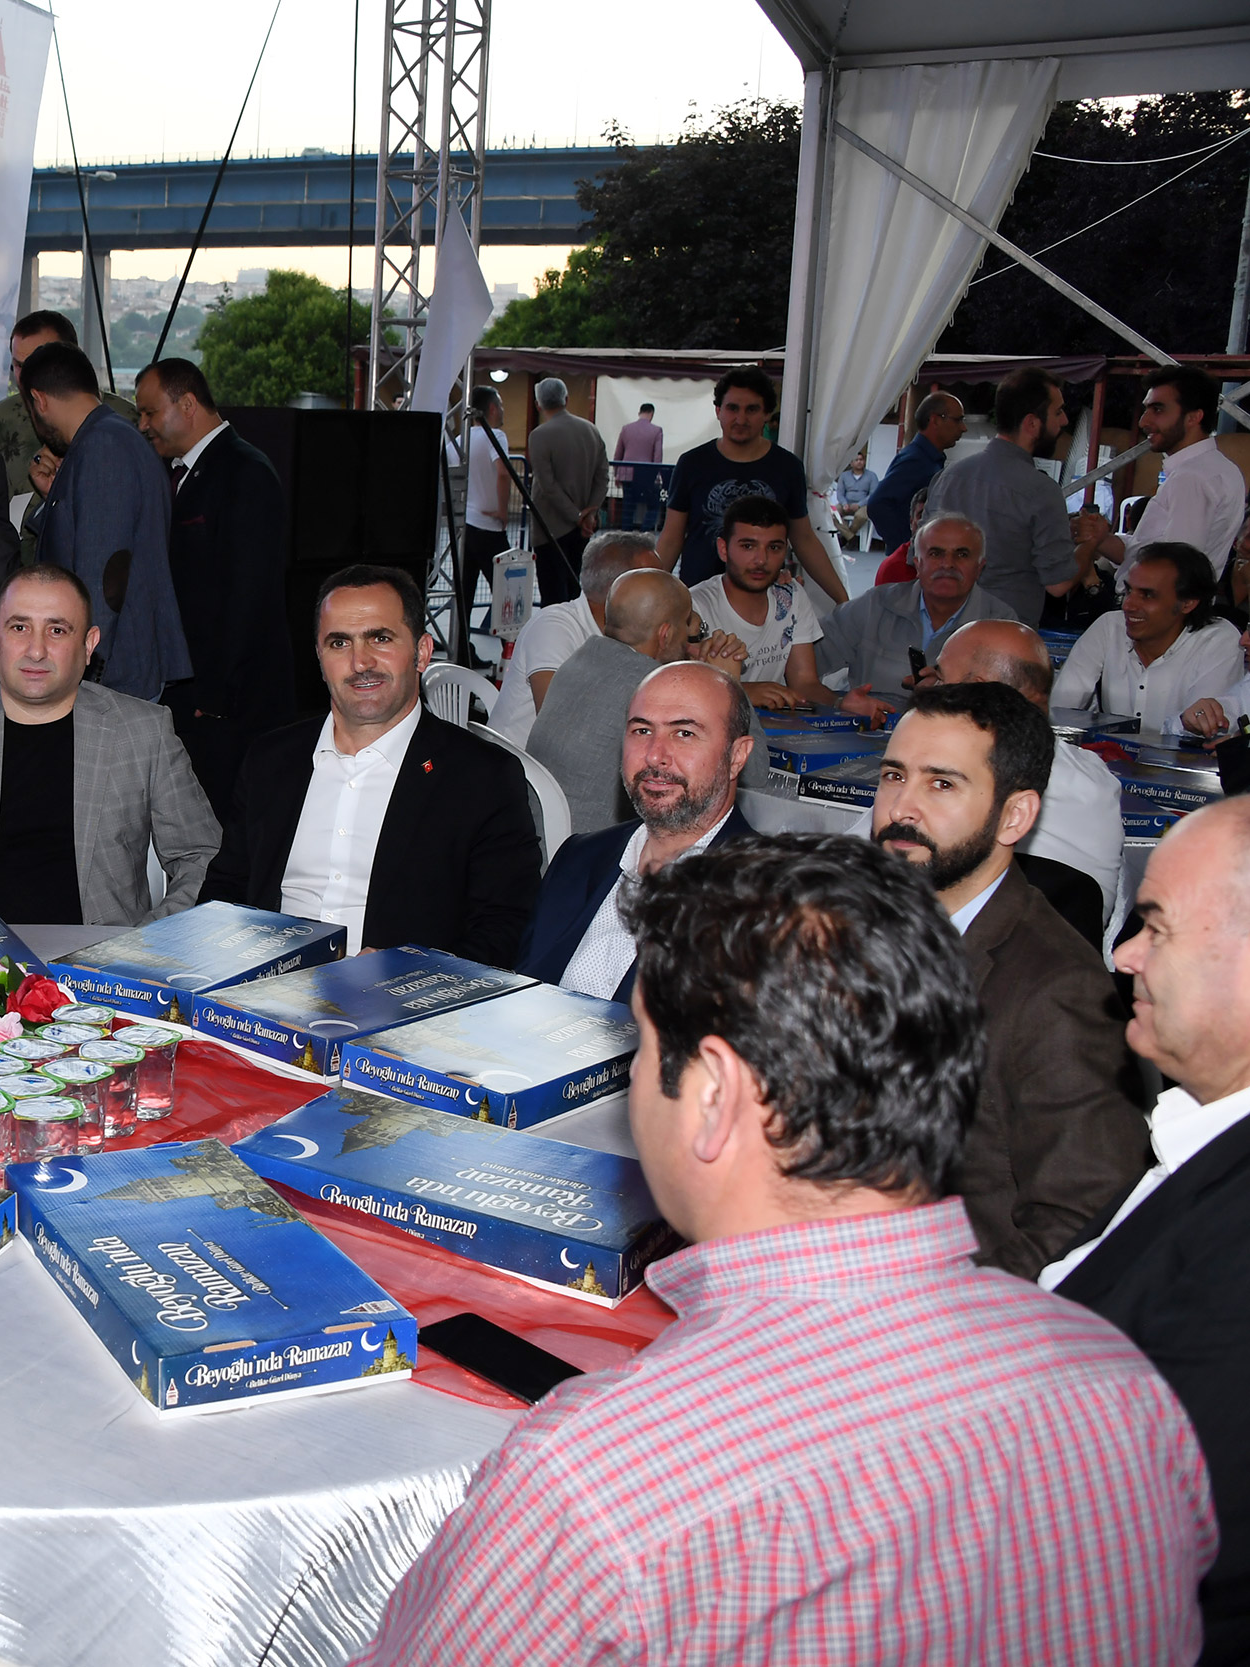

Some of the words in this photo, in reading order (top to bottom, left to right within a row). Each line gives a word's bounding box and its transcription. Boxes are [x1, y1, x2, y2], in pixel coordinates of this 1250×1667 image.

[58, 974, 113, 994] Beyoğlu'nda
[113, 982, 153, 1002] Ramazan
[202, 1006, 252, 1033] Beyoğlu'nda
[253, 1020, 289, 1045] Ramazan
[355, 1056, 415, 1088] Beyoğlu'nda
[416, 1073, 460, 1101] Ramazan
[405, 1176, 604, 1232] Beyoğlu'nda
[455, 1167, 594, 1210] Ramazan
[410, 1203, 478, 1240] Ramazan
[87, 1235, 209, 1332] Beyoğlu'nda
[157, 1242, 251, 1311] Ramazan
[184, 1351, 283, 1388] Beyoğlu'nda
[283, 1340, 353, 1367] Ramazan
